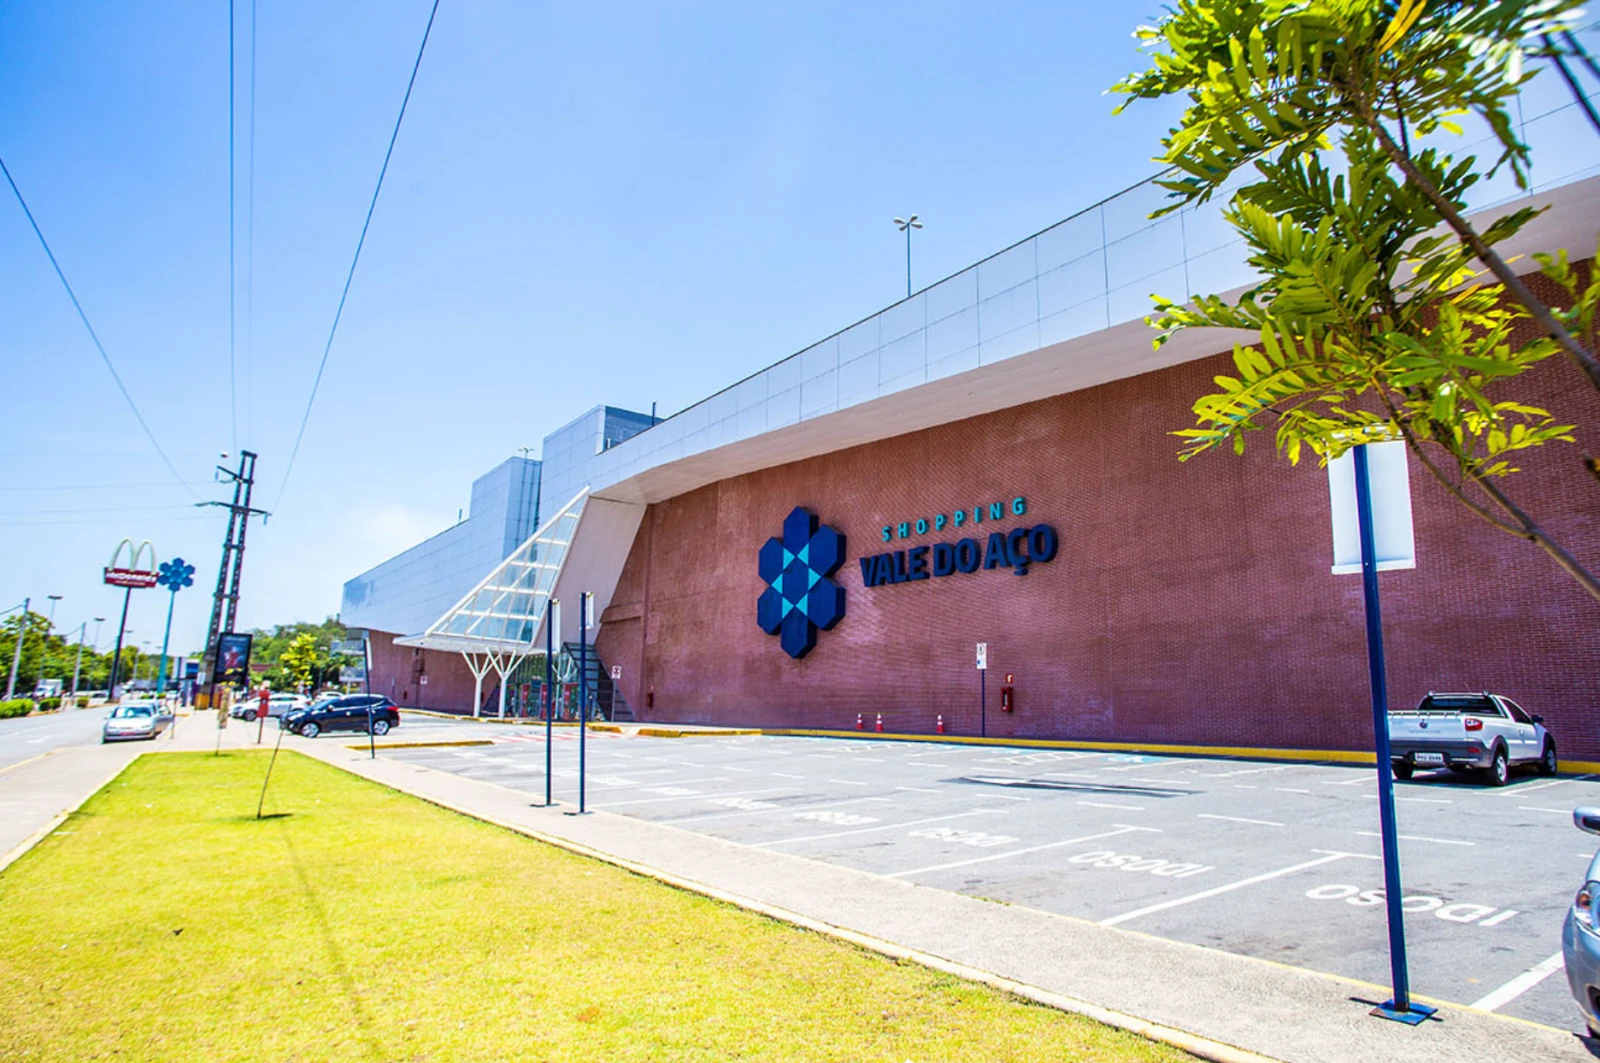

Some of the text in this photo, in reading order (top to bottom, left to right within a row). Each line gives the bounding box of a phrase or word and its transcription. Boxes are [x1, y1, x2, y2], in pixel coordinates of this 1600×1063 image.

[881, 497, 1027, 542] SHOPPING
[859, 524, 1059, 588] VALE DO AÇO
[1067, 851, 1216, 879] IDOSO
[1305, 884, 1520, 926] IDOSO
